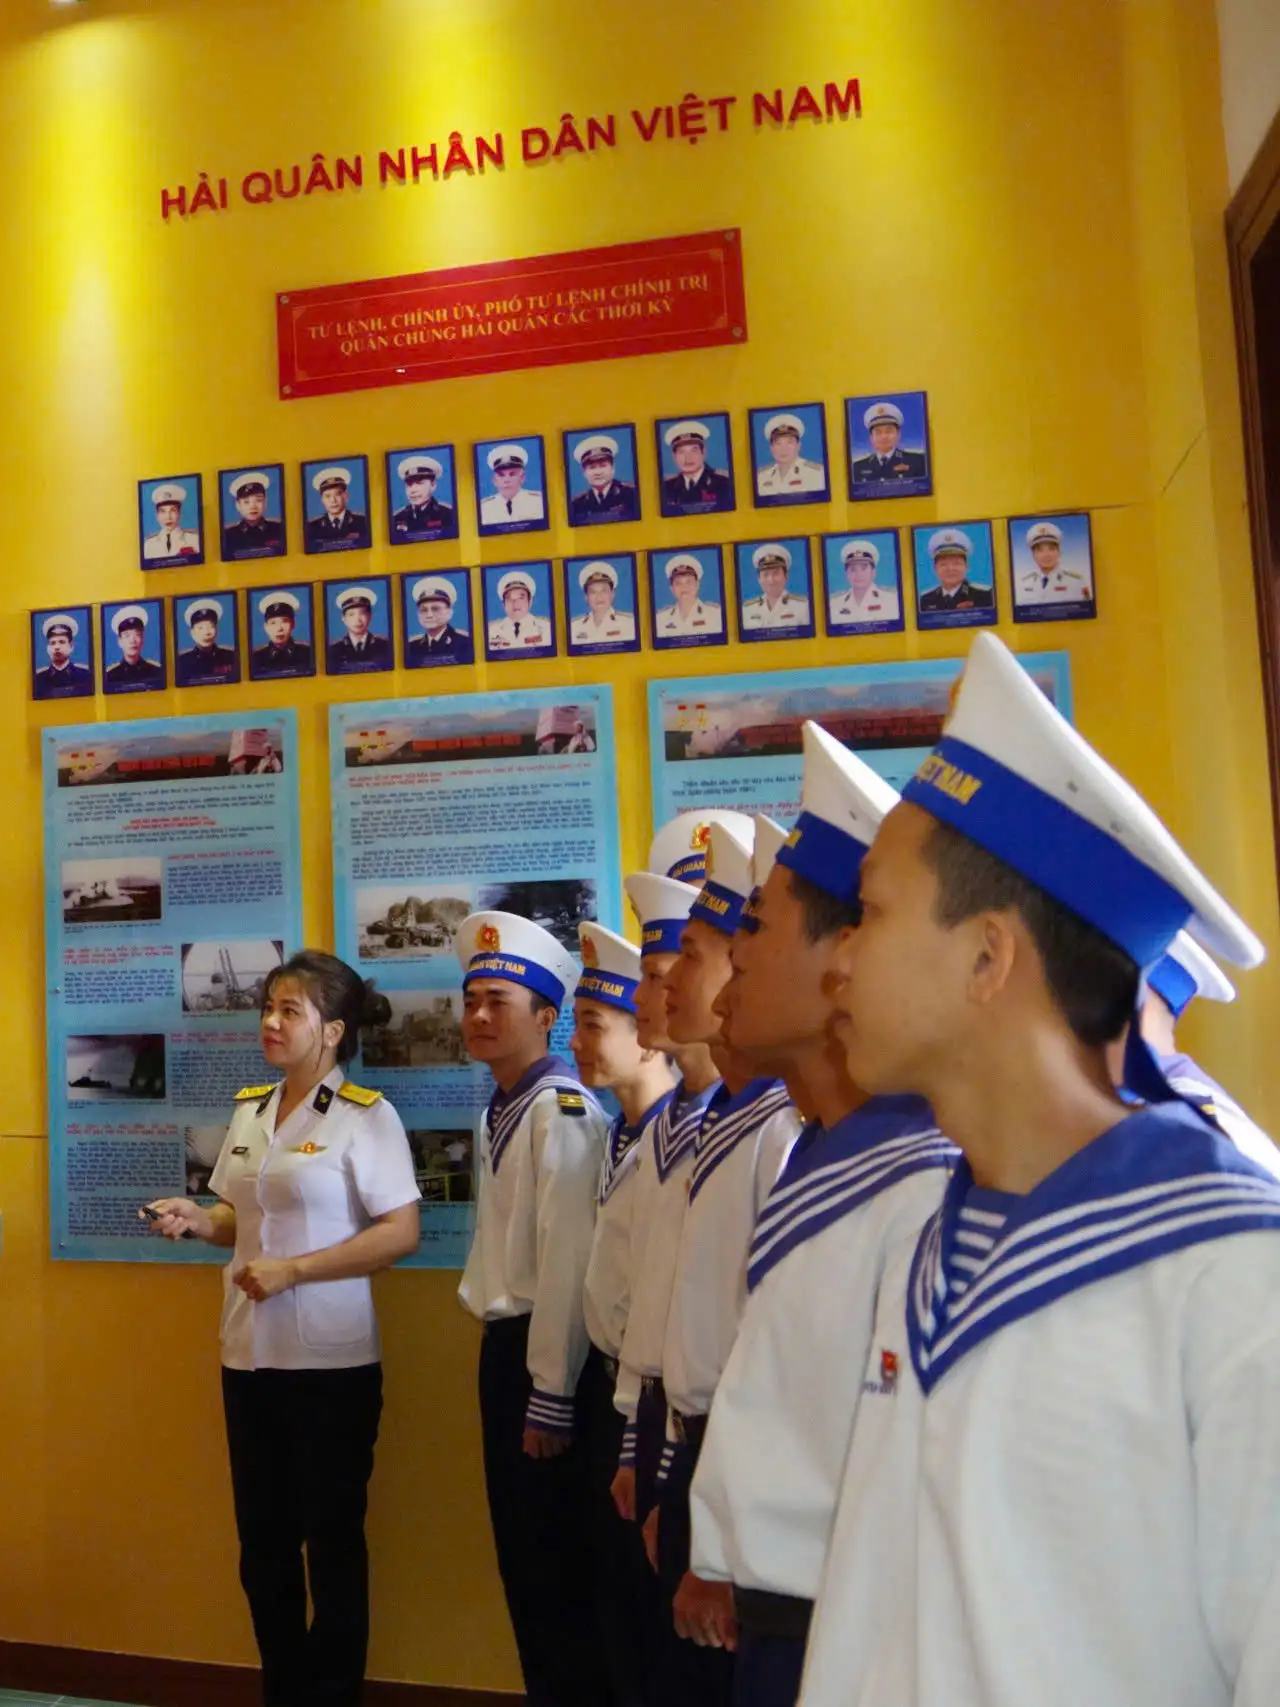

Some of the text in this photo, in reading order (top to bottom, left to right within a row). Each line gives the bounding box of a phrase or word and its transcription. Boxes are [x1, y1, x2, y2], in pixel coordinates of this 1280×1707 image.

[161, 78, 862, 219] HẢI QUÂN NHÂN DÂN VIỆT NAM
[933, 764, 983, 805] NAM
[505, 960, 527, 976] NAM
[601, 980, 625, 998] NAM
